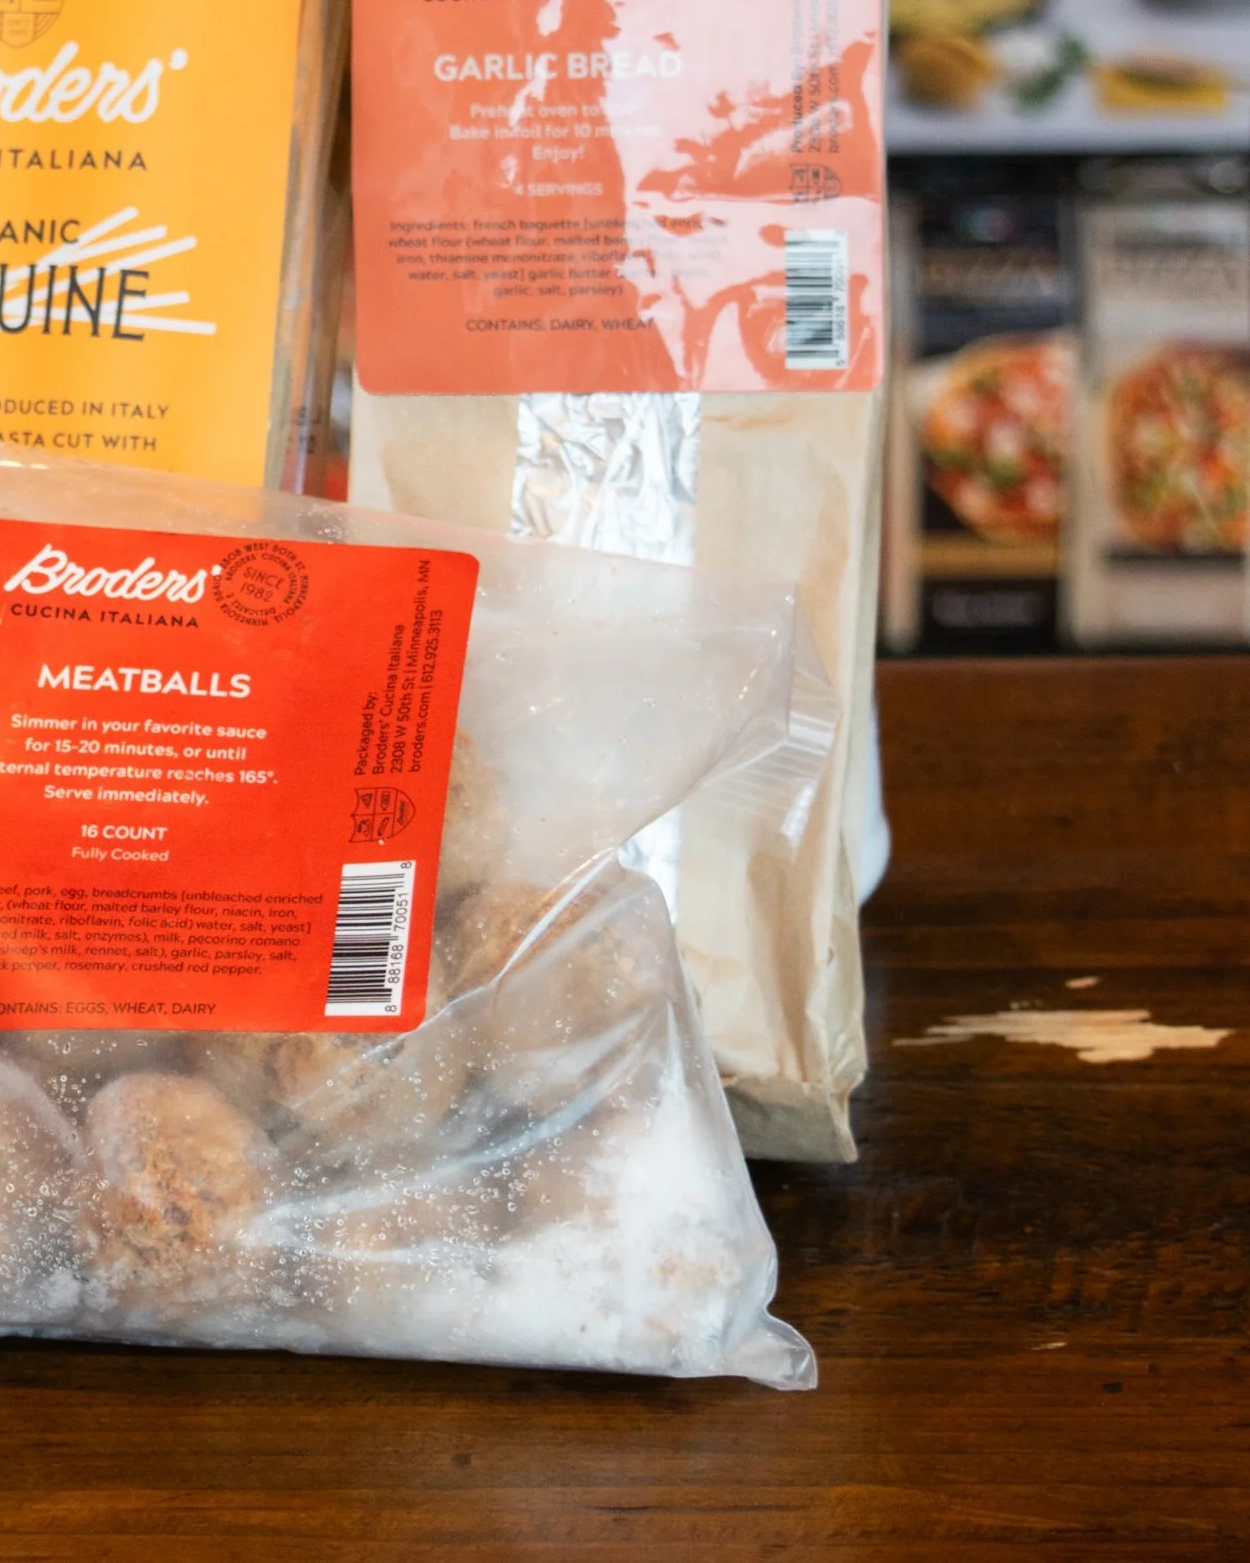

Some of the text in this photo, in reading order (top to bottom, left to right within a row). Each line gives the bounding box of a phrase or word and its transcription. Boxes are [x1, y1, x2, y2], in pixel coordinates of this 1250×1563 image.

[433, 50, 685, 82] GARLIC BREAD
[539, 104, 600, 118] oven to
[449, 124, 591, 140] Bake for 10
[532, 145, 585, 165] Enjoy!
[527, 182, 603, 197] SERVINGS
[466, 318, 654, 332] CONTAINS: DAIRY, WHEAT
[82, 401, 103, 416] IN
[111, 403, 170, 420] ITALY
[52, 433, 94, 449] CUT
[101, 435, 157, 452] WITH
[4, 544, 222, 604] Broders'
[244, 566, 285, 589] SINCE
[240, 582, 273, 602] 1982
[10, 603, 199, 629] CUCINA ITALIANA
[390, 560, 431, 773] 2308 W 50th St Minneapolis, MN
[37, 663, 252, 700] MEATBALLS
[409, 609, 443, 772] broders.com 612.925.3113
[372, 624, 404, 775] Broders' Cucina Italiana
[10, 714, 267, 739] Simmer in your favorite sauce
[354, 692, 379, 776] Packaged by:
[25, 737, 246, 760] for 15-20 minutes, or until
[54, 764, 162, 783] temperature
[166, 766, 235, 783] reaches
[239, 769, 279, 785] 165°.
[44, 785, 210, 807] Serve immediately.
[80, 824, 168, 841] 16 COUNT
[71, 846, 169, 863] Fully Cooked
[24, 886, 57, 897] pork,
[60, 887, 88, 899] egg,
[92, 888, 178, 900] breadcrumbs
[181, 891, 262, 903] [unbleached
[265, 893, 323, 904] enriched
[6, 900, 51, 911] (wheat
[54, 901, 88, 912] flour,
[92, 901, 137, 913] malted
[141, 903, 181, 916] barley
[184, 904, 219, 917] flour,
[222, 907, 264, 918] niacin,
[269, 908, 298, 919] iron,
[60, 915, 124, 928] riboflavin,
[128, 916, 157, 928] folic
[160, 918, 193, 930] acid)
[196, 920, 236, 932] water,
[240, 922, 268, 933] salt,
[271, 922, 312, 934] yeast]
[20, 930, 51, 941] milk,
[54, 930, 81, 941] salt,
[85, 931, 150, 944] enzymes),
[153, 933, 184, 945] milk,
[188, 935, 246, 946] pecorino
[250, 937, 300, 947] romano
[385, 859, 412, 1014] 8 88168 70051 8
[51, 944, 81, 956] milk,
[85, 945, 132, 958] rennet,
[135, 946, 167, 958] salt),
[171, 948, 211, 960] garlic,
[214, 949, 265, 963] parsley,
[269, 951, 297, 961] salt,
[64, 962, 128, 974] rosemary,
[131, 961, 183, 973] crushed
[187, 963, 209, 973] red
[212, 964, 262, 976] pepper.
[65, 1002, 108, 1017] EGGS,
[113, 1002, 168, 1017] WHEAT,
[171, 1003, 216, 1017] DAIRY
